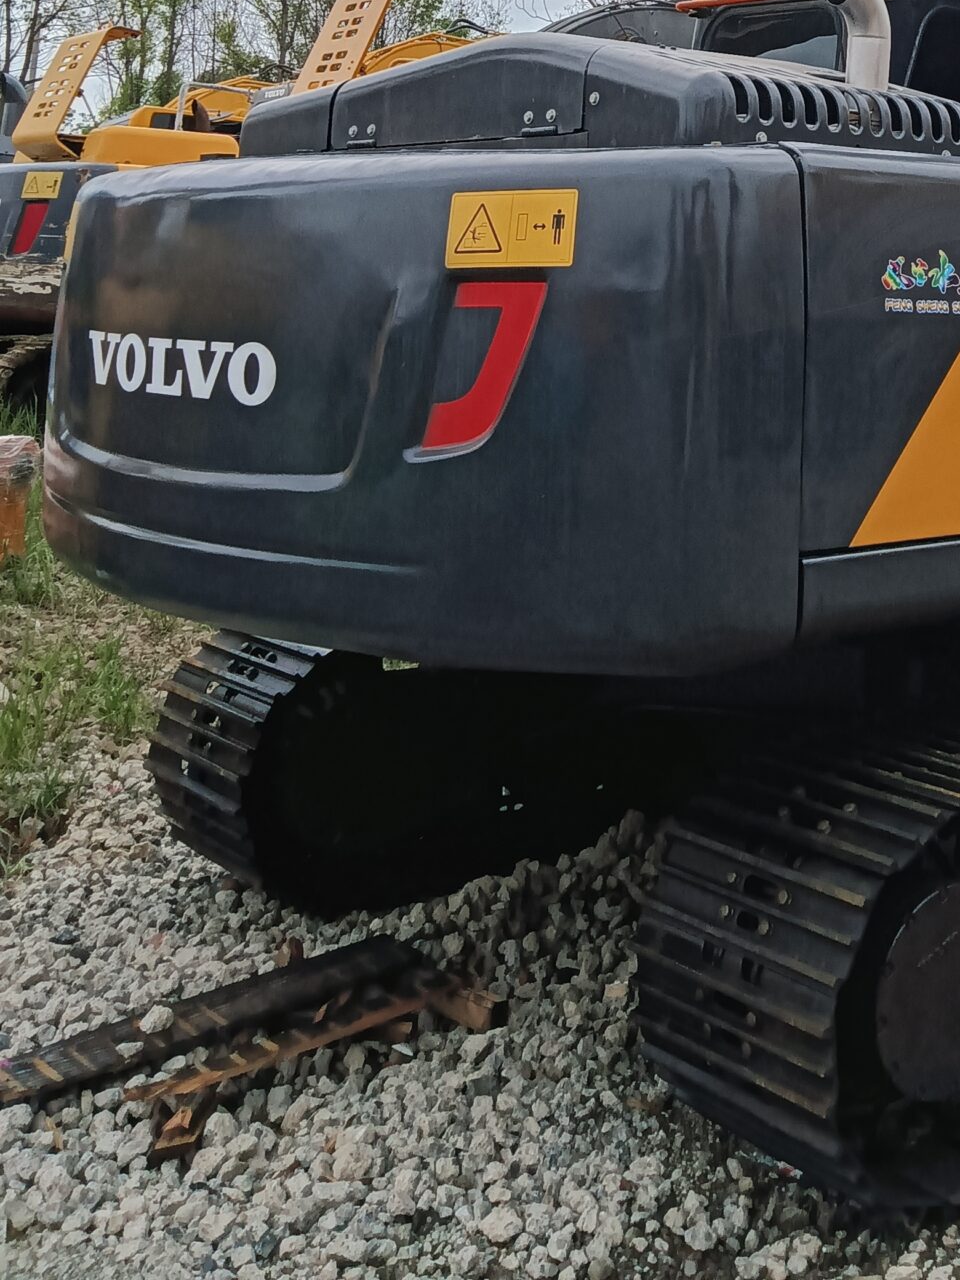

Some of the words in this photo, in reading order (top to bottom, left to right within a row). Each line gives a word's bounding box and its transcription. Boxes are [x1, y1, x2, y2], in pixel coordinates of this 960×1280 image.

[885, 297, 913, 312] FENG
[916, 299, 950, 314] SHENG
[89, 329, 277, 407] VOLVO
